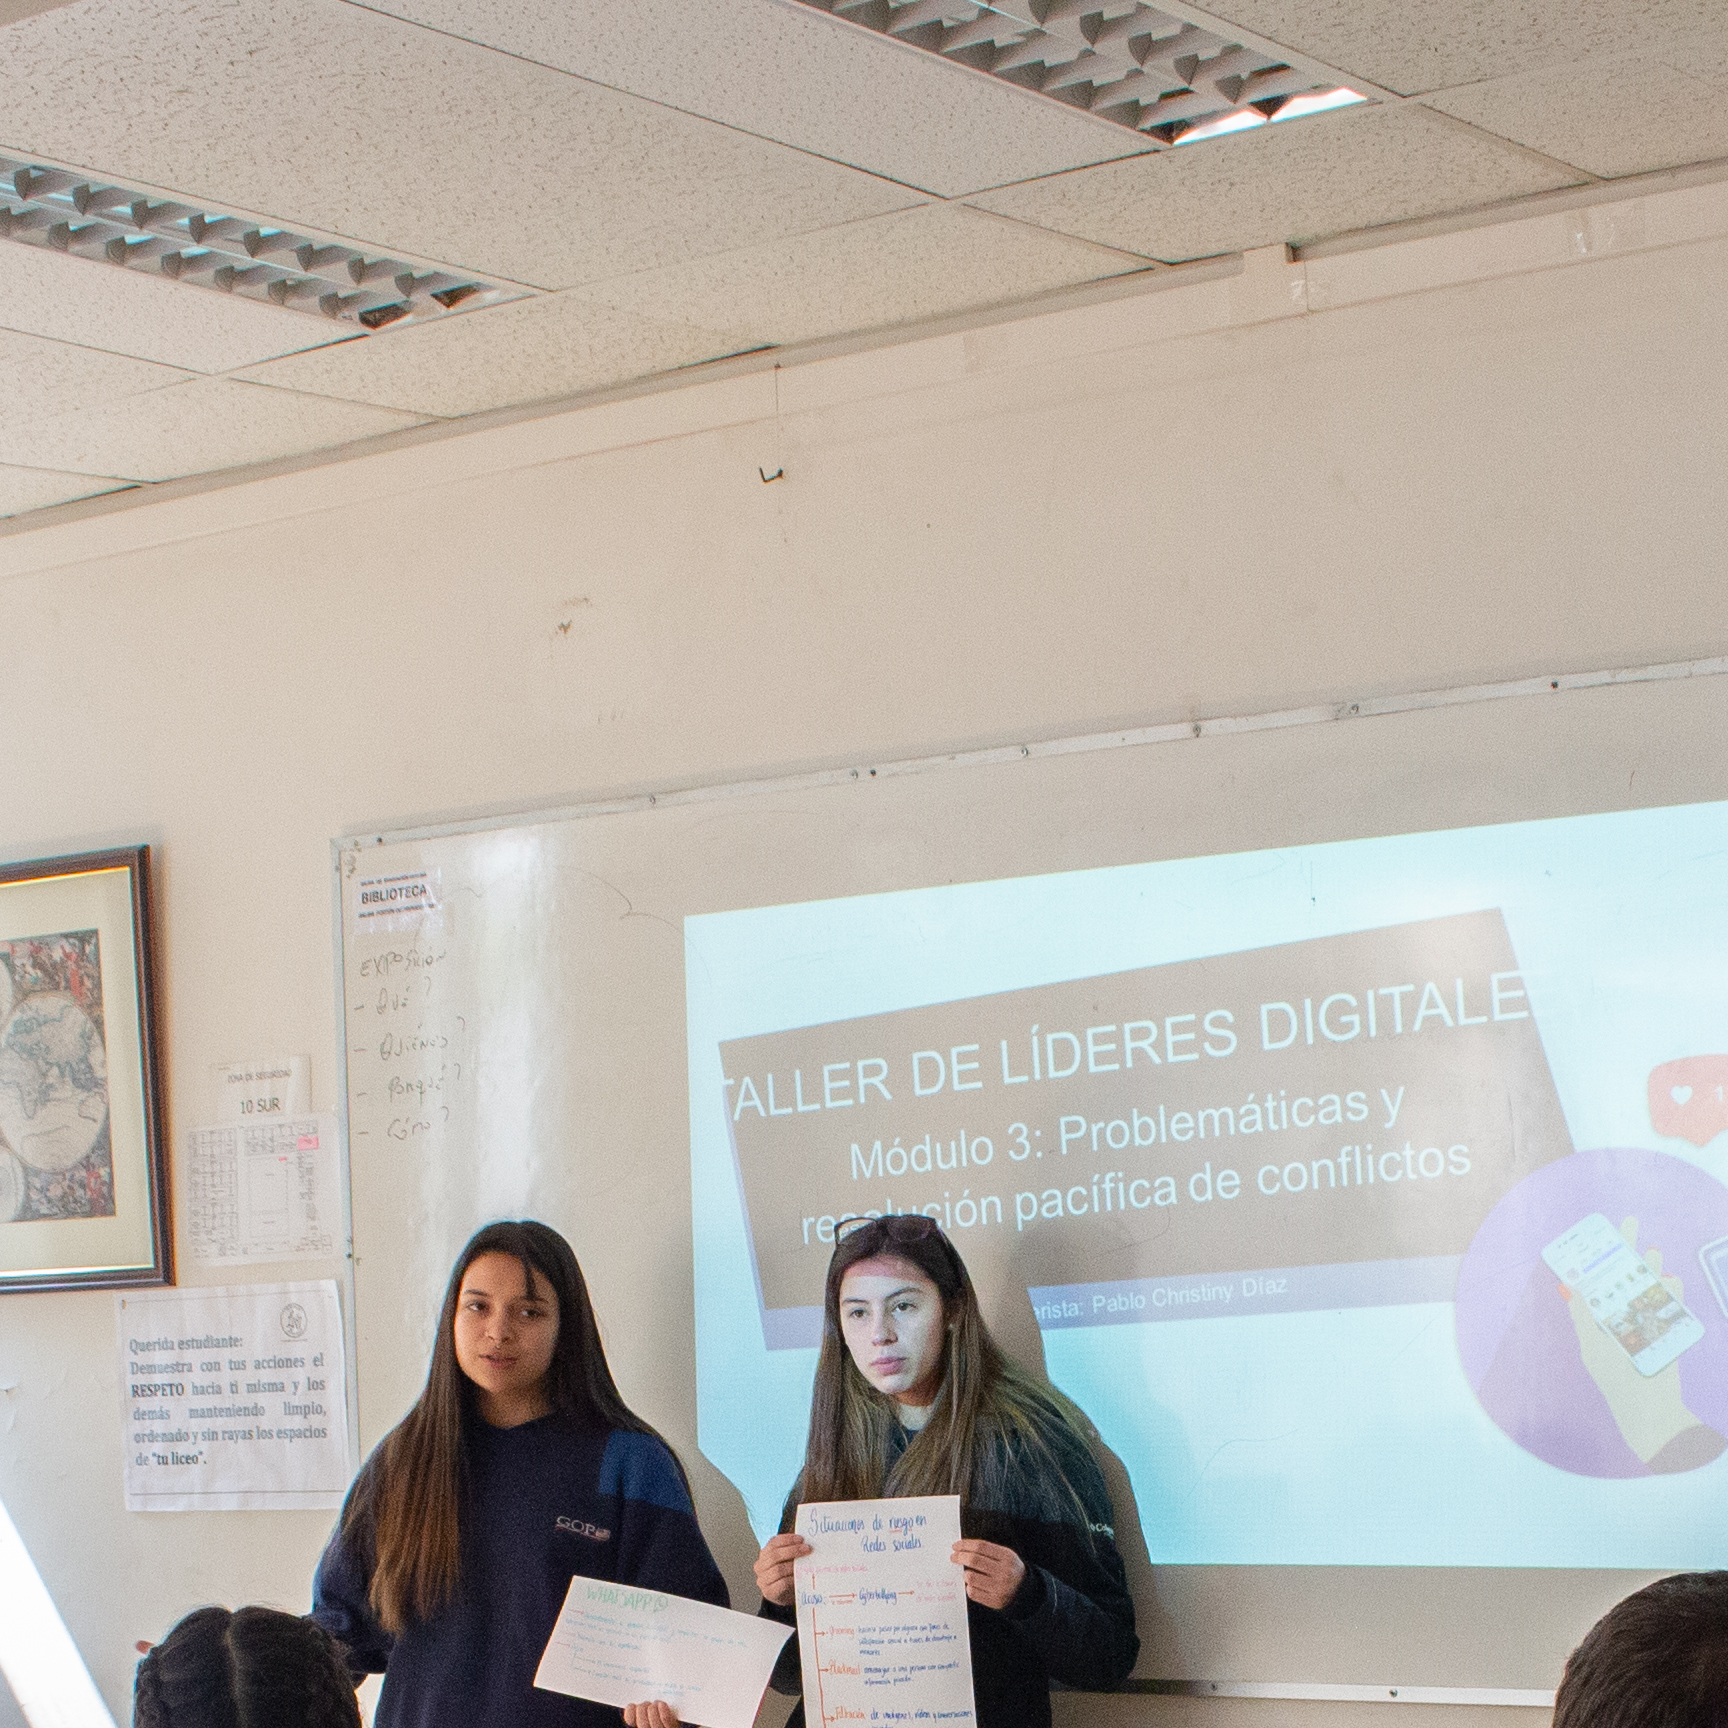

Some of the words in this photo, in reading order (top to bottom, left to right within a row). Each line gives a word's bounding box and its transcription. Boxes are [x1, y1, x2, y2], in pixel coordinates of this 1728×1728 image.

[360, 883, 427, 905] BIBLIOTECA
[911, 1043, 984, 1098] DE
[1000, 1009, 1238, 1086] LÍDERES
[240, 1099, 254, 1114] 10
[257, 1097, 282, 1113] SUR
[850, 1129, 995, 1180] Módulo
[1007, 1122, 1043, 1161] 3:
[1059, 1090, 1370, 1155] Problemáticas
[1380, 1086, 1405, 1129] y
[803, 1189, 1003, 1244] reción
[1015, 1171, 1178, 1231] pacífica
[1189, 1161, 1241, 1203] de
[1257, 1140, 1472, 1197] conflictos
[1092, 1294, 1146, 1314] Pablo
[1152, 1283, 1234, 1307] Christiny
[1242, 1276, 1287, 1297] Díaz
[129, 1338, 175, 1355] Querida
[178, 1335, 243, 1350] estudiante:
[129, 1361, 193, 1375] Demuestra
[200, 1362, 221, 1372] con
[228, 1357, 247, 1371] tus
[254, 1355, 305, 1370] acciones
[313, 1353, 324, 1368] el
[131, 1383, 184, 1398] RESPETO
[191, 1380, 222, 1396] hacia
[229, 1380, 239, 1395] ti
[246, 1380, 285, 1395] misma
[291, 1381, 300, 1396] y
[307, 1377, 326, 1391] los
[133, 1405, 170, 1421] demás
[189, 1402, 265, 1419] manteniendo
[283, 1401, 327, 1419] limpio,
[133, 1428, 189, 1443] ordenado
[191, 1431, 199, 1446] y
[201, 1428, 219, 1442] sin
[221, 1428, 254, 1444] rayas
[256, 1426, 274, 1440] los
[276, 1426, 328, 1443] espacios
[135, 1452, 150, 1467] de
[808, 1507, 865, 1536] Situaciones
[872, 1513, 884, 1531] de
[861, 1535, 887, 1553] Redes
